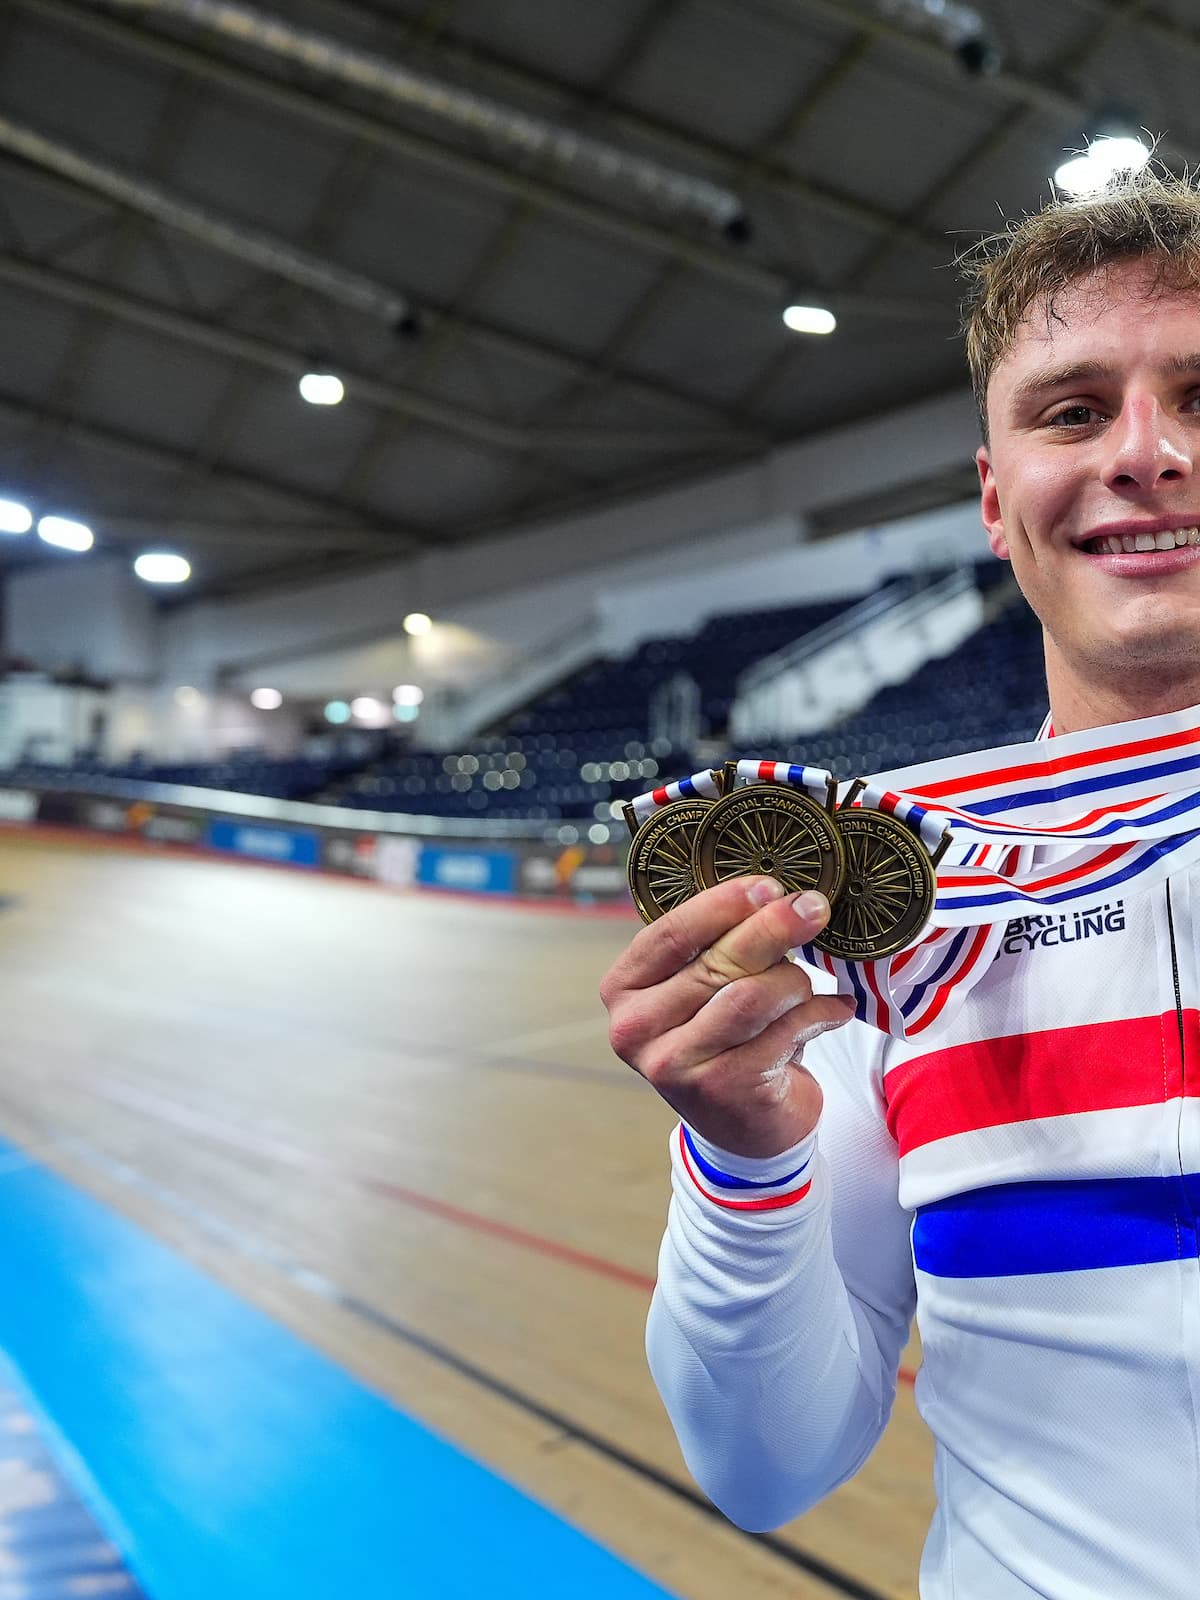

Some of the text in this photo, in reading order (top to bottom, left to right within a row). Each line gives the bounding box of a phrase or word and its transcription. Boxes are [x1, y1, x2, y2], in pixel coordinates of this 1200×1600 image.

[638, 824, 668, 871] NATIONAL
[713, 797, 832, 851] NATIONAL CHAMPIONSHIP
[837, 820, 925, 898] IONAL CHAMPIONSHIP
[829, 936, 876, 952] CYCLING
[1003, 909, 1125, 954] CYCLING
